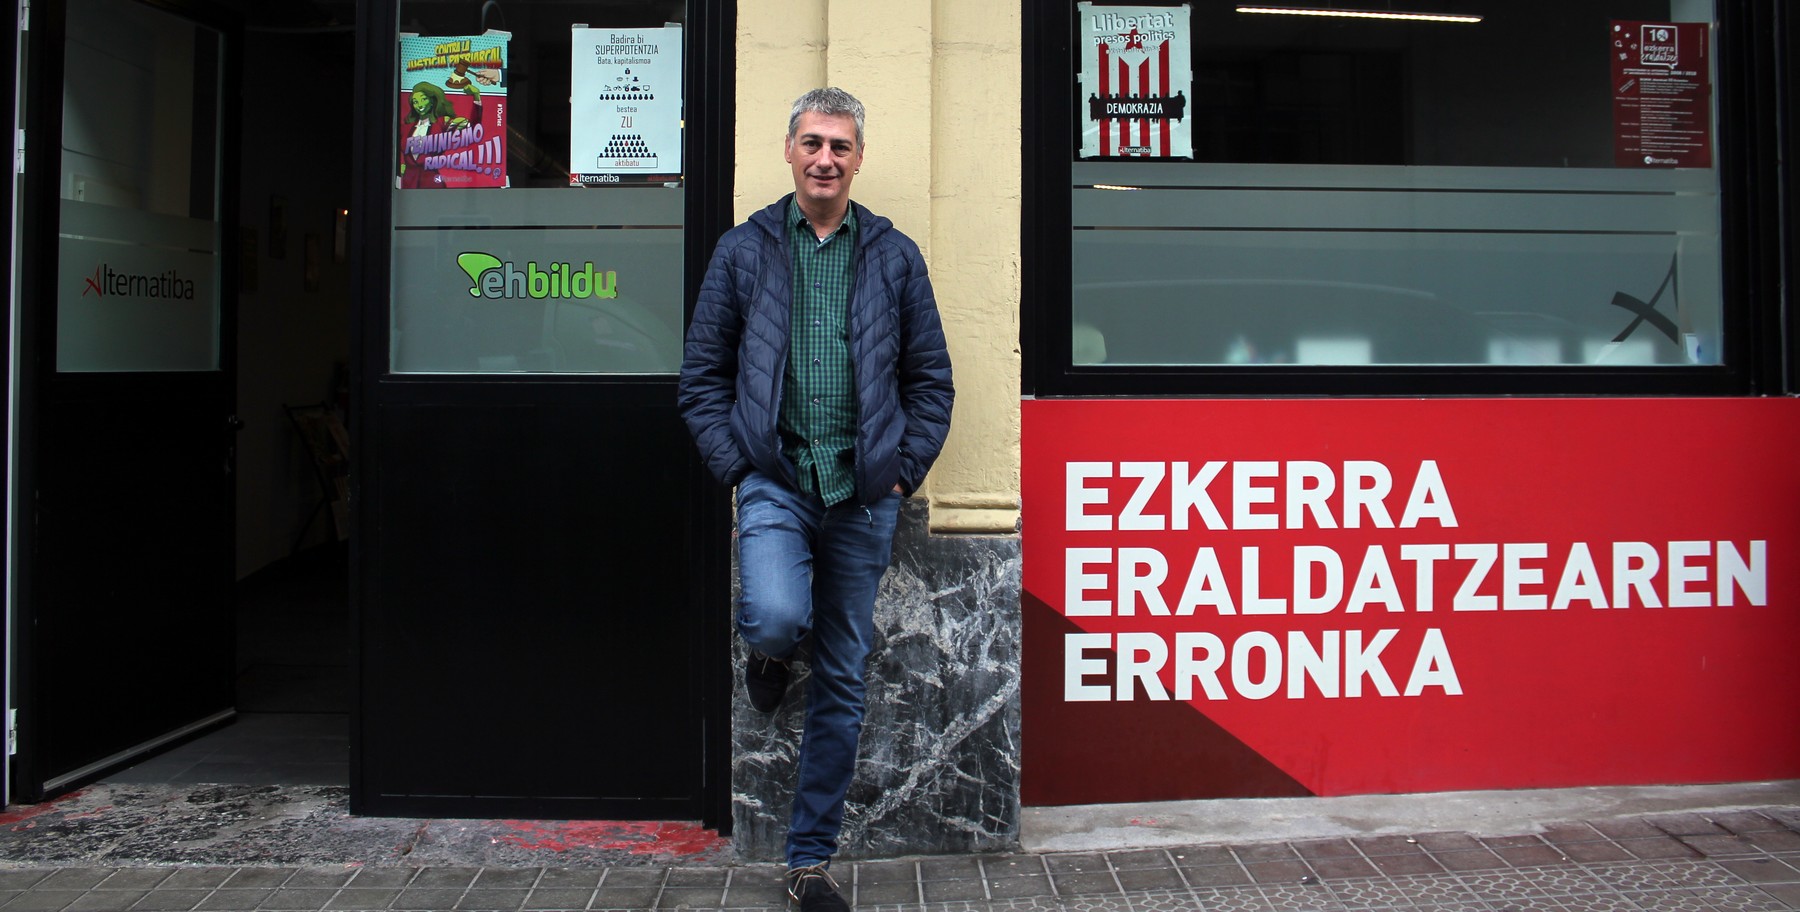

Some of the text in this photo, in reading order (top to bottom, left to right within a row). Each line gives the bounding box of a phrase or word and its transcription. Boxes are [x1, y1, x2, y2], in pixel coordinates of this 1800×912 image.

[1092, 11, 1174, 32] Llibertat
[610, 33, 644, 44] Badira bi
[1094, 34, 1131, 46] presos
[434, 39, 471, 56] CONTRA LA
[595, 44, 660, 55] SUPERPOTENTZIA
[407, 45, 503, 72] JUSTICIA PATRIARCAL
[614, 56, 651, 66] kapitalismoa
[616, 104, 638, 113] bestea
[1106, 102, 1164, 114] DEMOKRAZIA
[620, 116, 633, 129] ZU
[404, 123, 484, 155] FEMINISMO
[424, 135, 502, 178] RADICAL!!!
[614, 159, 640, 167] aktibatu
[482, 261, 617, 299] ehbildu
[1065, 460, 1458, 530] EZKERRA
[1064, 540, 1767, 617] ERALDATZEAREN
[1064, 628, 1463, 702] ERRONKA
